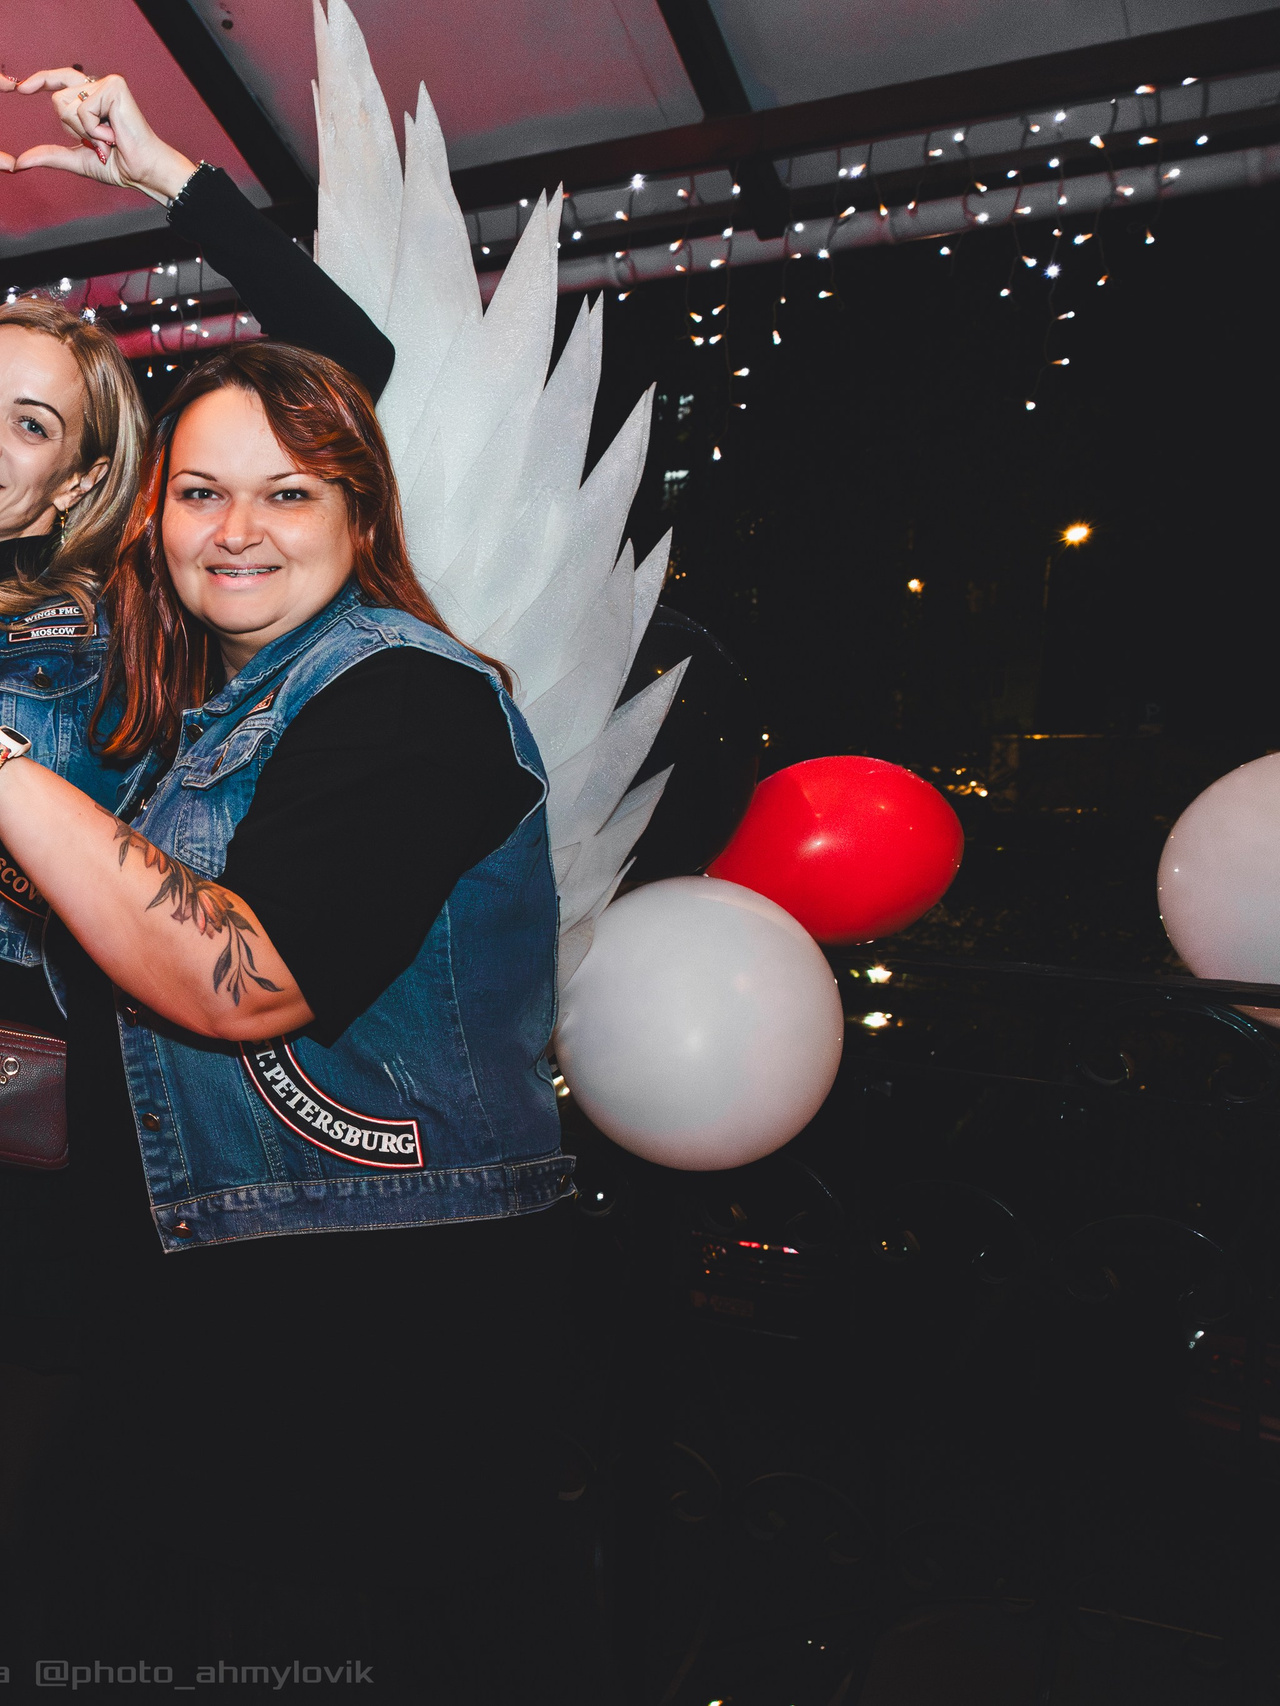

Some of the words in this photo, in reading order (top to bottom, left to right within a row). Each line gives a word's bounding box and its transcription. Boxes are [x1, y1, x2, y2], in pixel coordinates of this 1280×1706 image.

[24, 608, 57, 623] WINGS
[31, 627, 75, 638] MOSCOW
[263, 1063, 416, 1154] PETERSBURG
